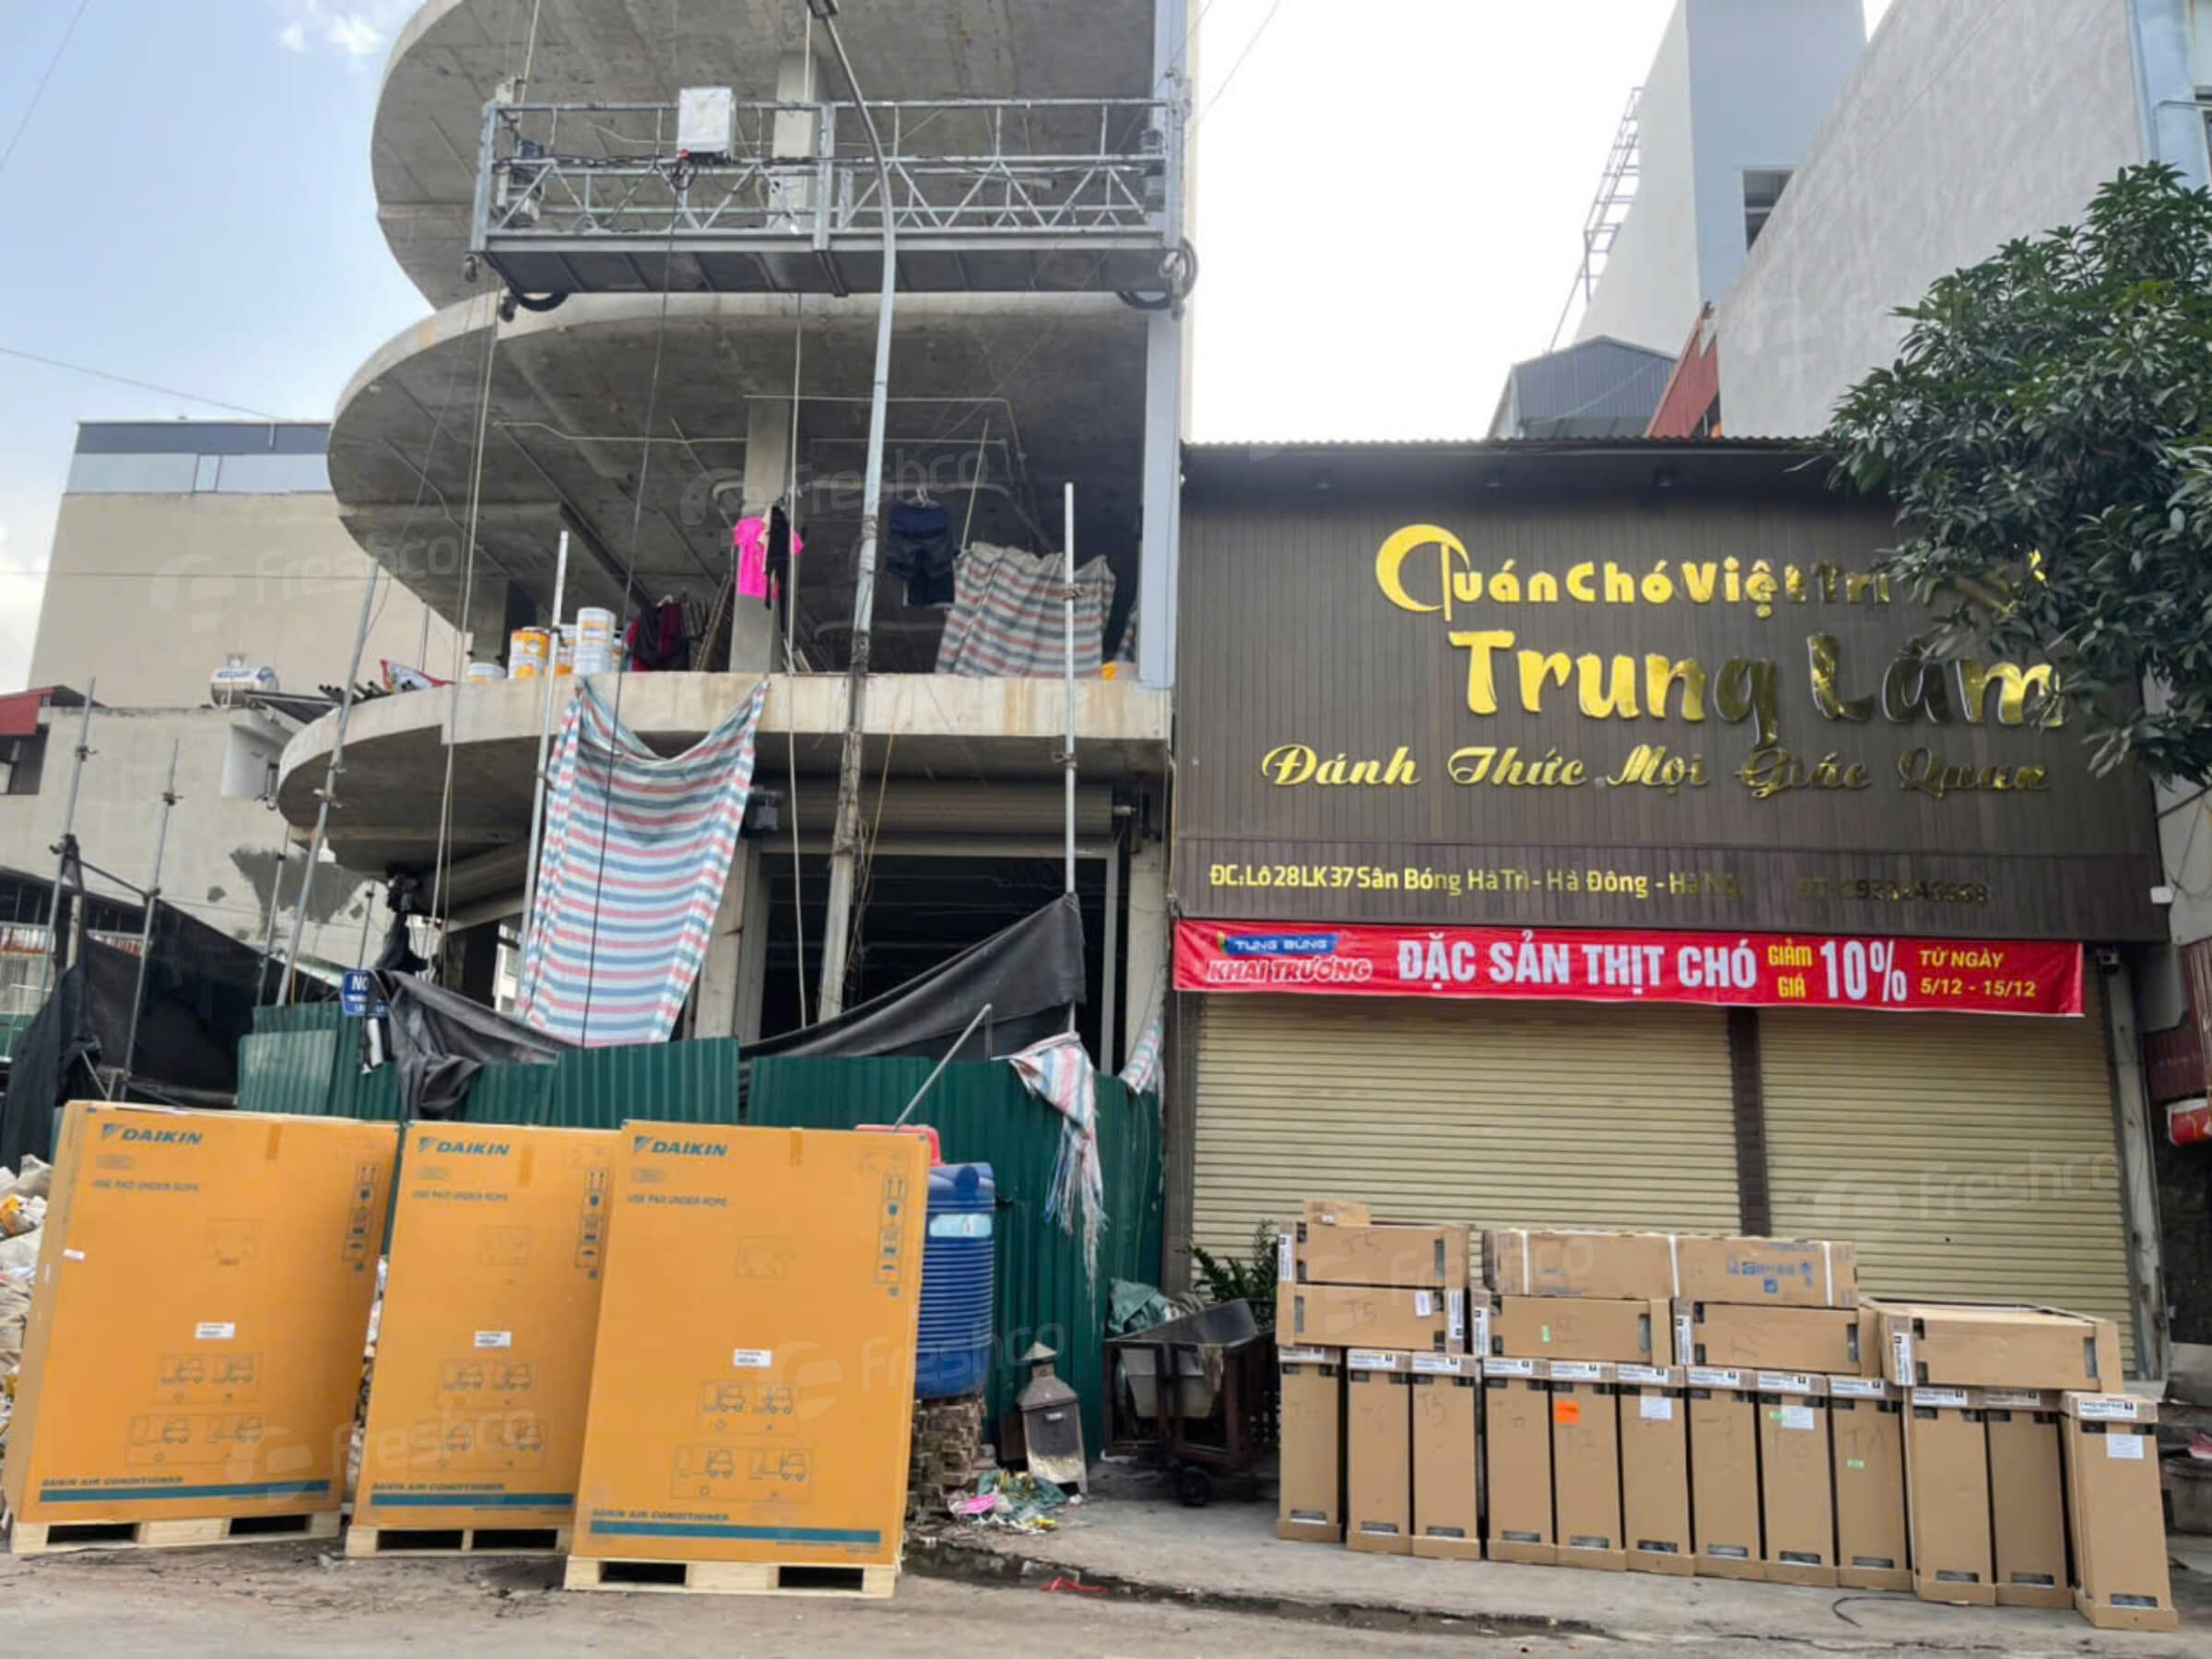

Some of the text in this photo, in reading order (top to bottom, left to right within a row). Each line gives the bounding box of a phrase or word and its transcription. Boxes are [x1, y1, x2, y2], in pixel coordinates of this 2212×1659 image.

[1376, 524, 1559, 621] Quán
[1567, 559, 1674, 604] Chó
[1450, 629, 1779, 747] Trung
[1262, 744, 2051, 799] Đánh Thức Mọi Giác Quan
[1357, 865, 1398, 889] Sân
[1405, 867, 1461, 896] Bóng
[1547, 869, 1579, 892] Hà
[1585, 869, 1649, 899] Đông
[1397, 929, 1757, 995] ĐẶC SẢN THỊT CHÓ
[1769, 937, 1812, 967] GIẢM
[1919, 946, 2005, 970] TỪ NGÀY
[1206, 959, 1268, 982] KHAI
[1819, 939, 1908, 1003] 10%
[1778, 972, 1806, 999] GIÁ
[1920, 977, 1963, 997] 5/12
[1983, 978, 2037, 998] 15/12
[122, 1128, 204, 1145] DAIKIN
[436, 1141, 511, 1156] DAIKIN
[652, 1141, 728, 1157] DAIKIN
